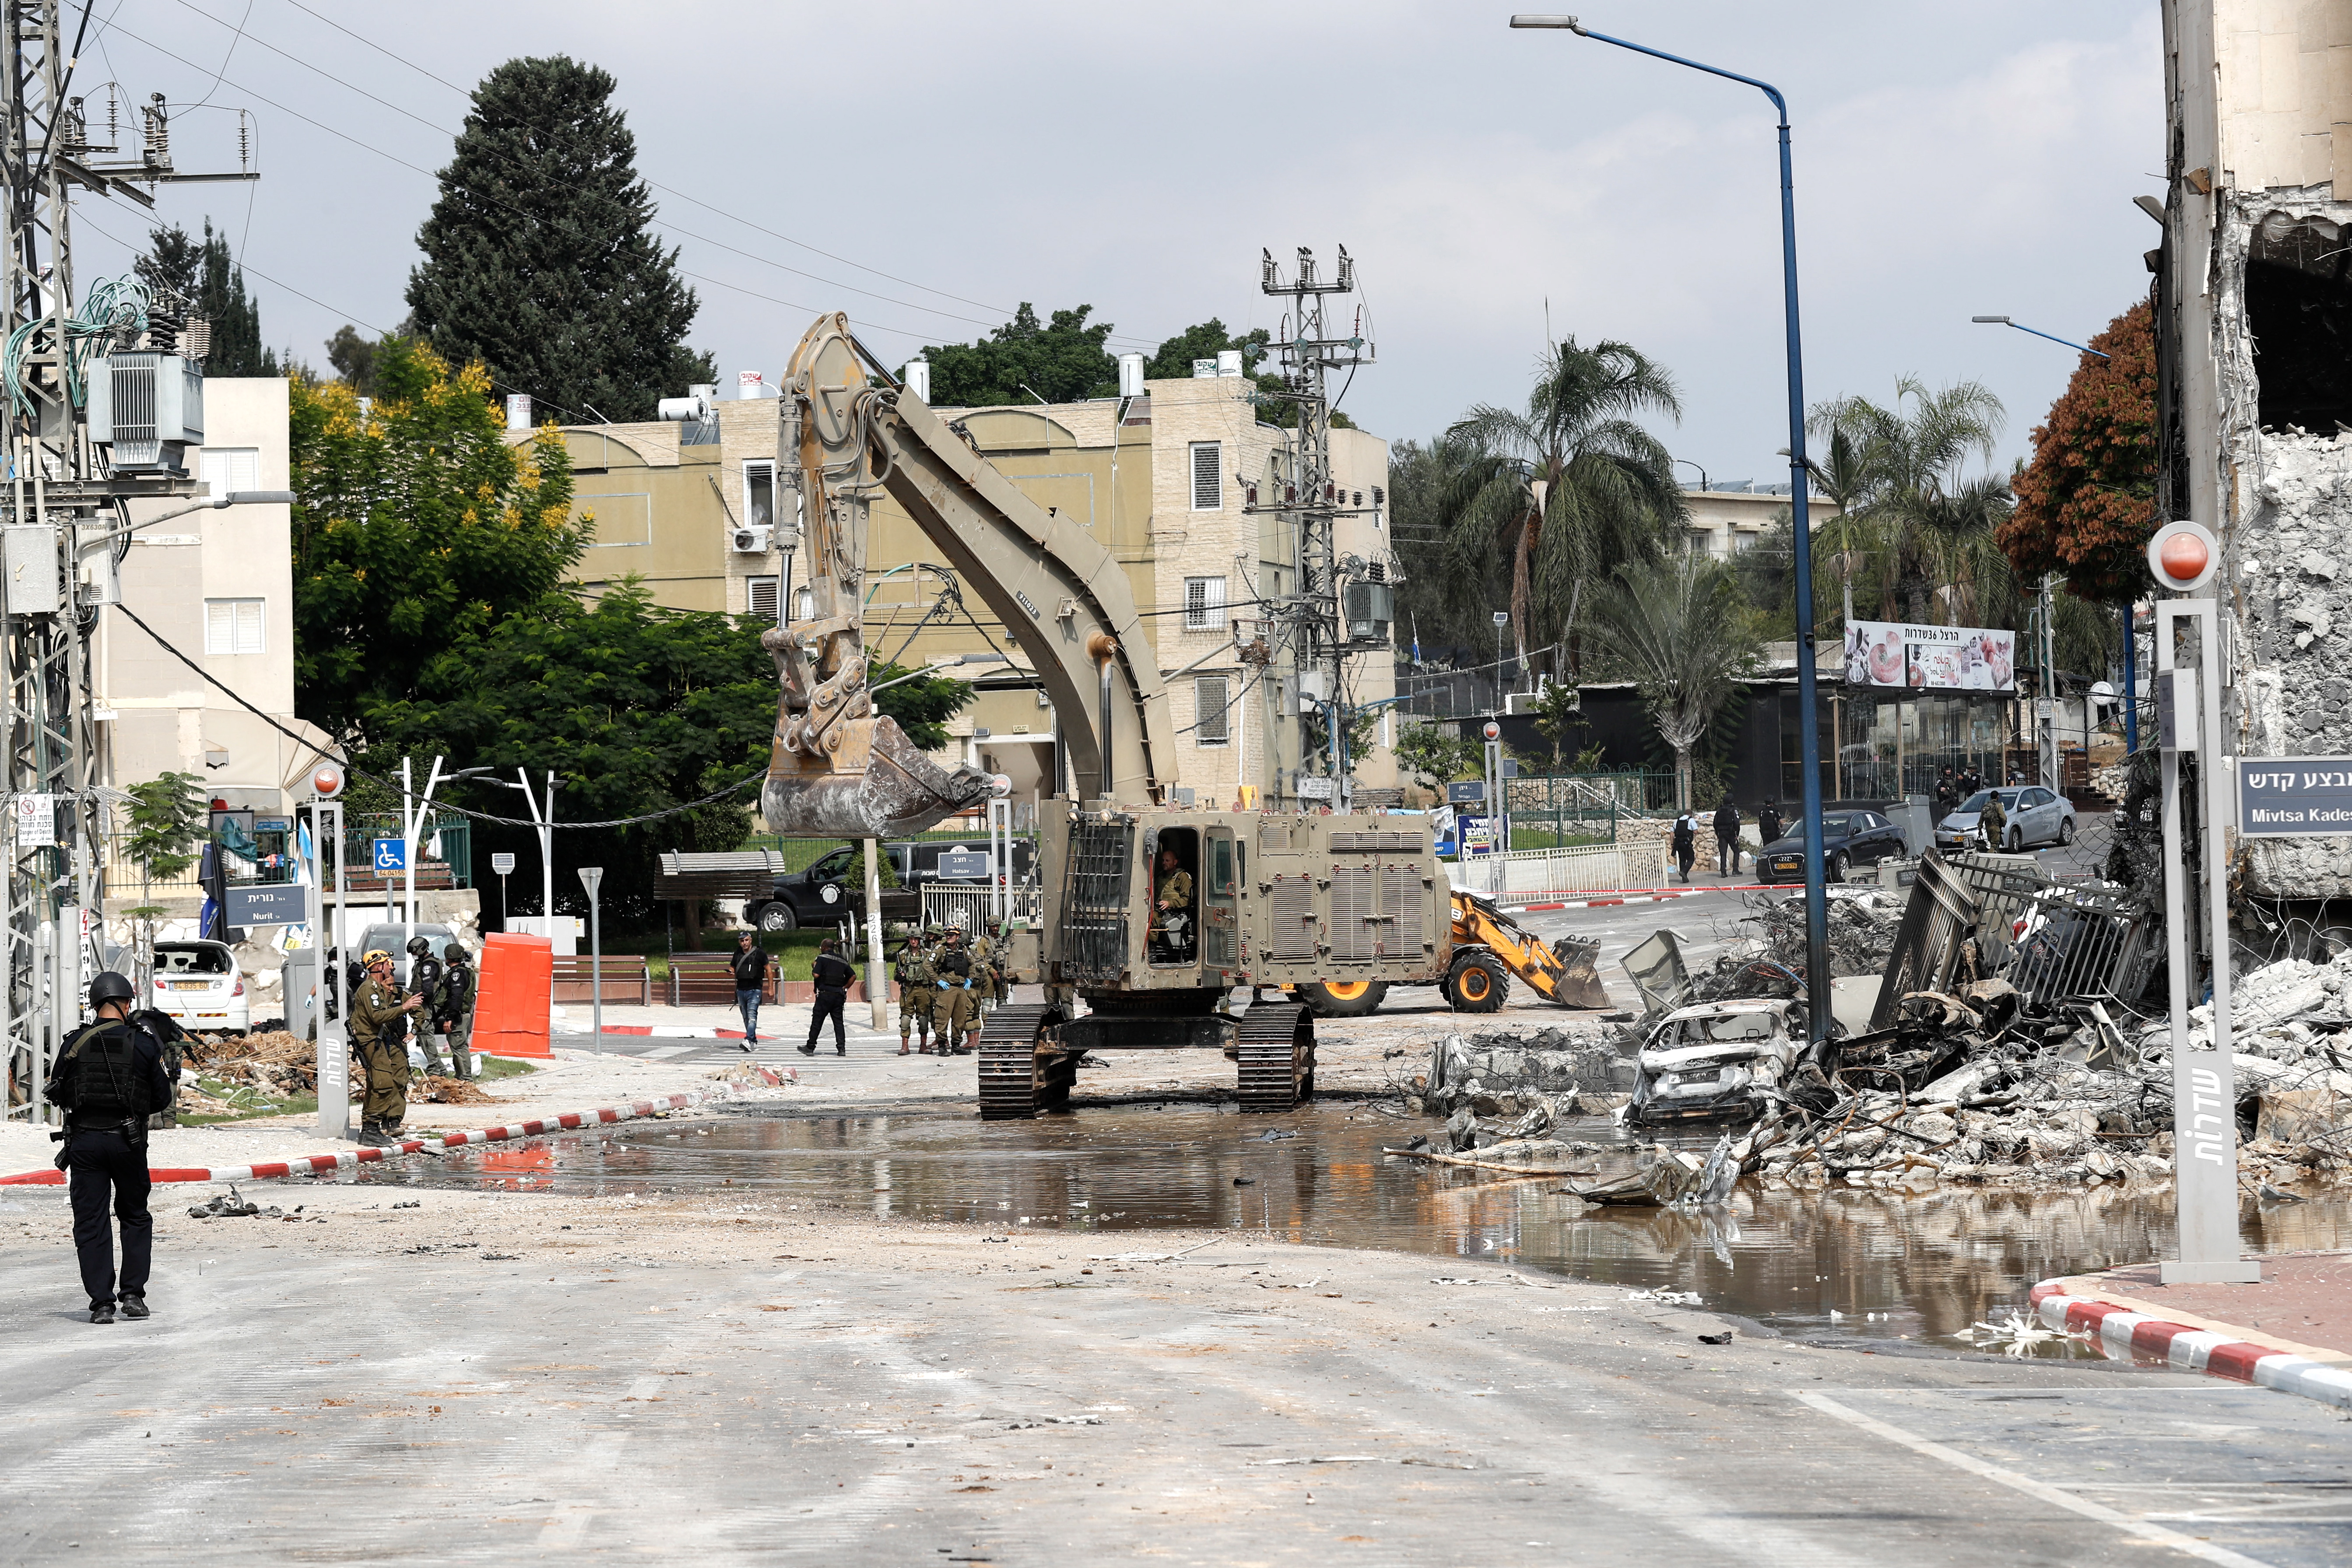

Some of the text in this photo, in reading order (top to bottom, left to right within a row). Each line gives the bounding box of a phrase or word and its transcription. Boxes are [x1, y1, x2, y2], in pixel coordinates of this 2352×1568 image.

[1196, 361, 1213, 369] יעקובי
[1019, 594, 1036, 614] 911023
[1940, 628, 1959, 641] הרצל
[2249, 773, 2295, 792] קדש
[2252, 809, 2304, 822] Mivtsa
[248, 894, 274, 903] נורית
[253, 912, 273, 920] Nurit
[322, 1038, 341, 1087] שדרות
[2184, 1067, 2223, 1166] שדרות
